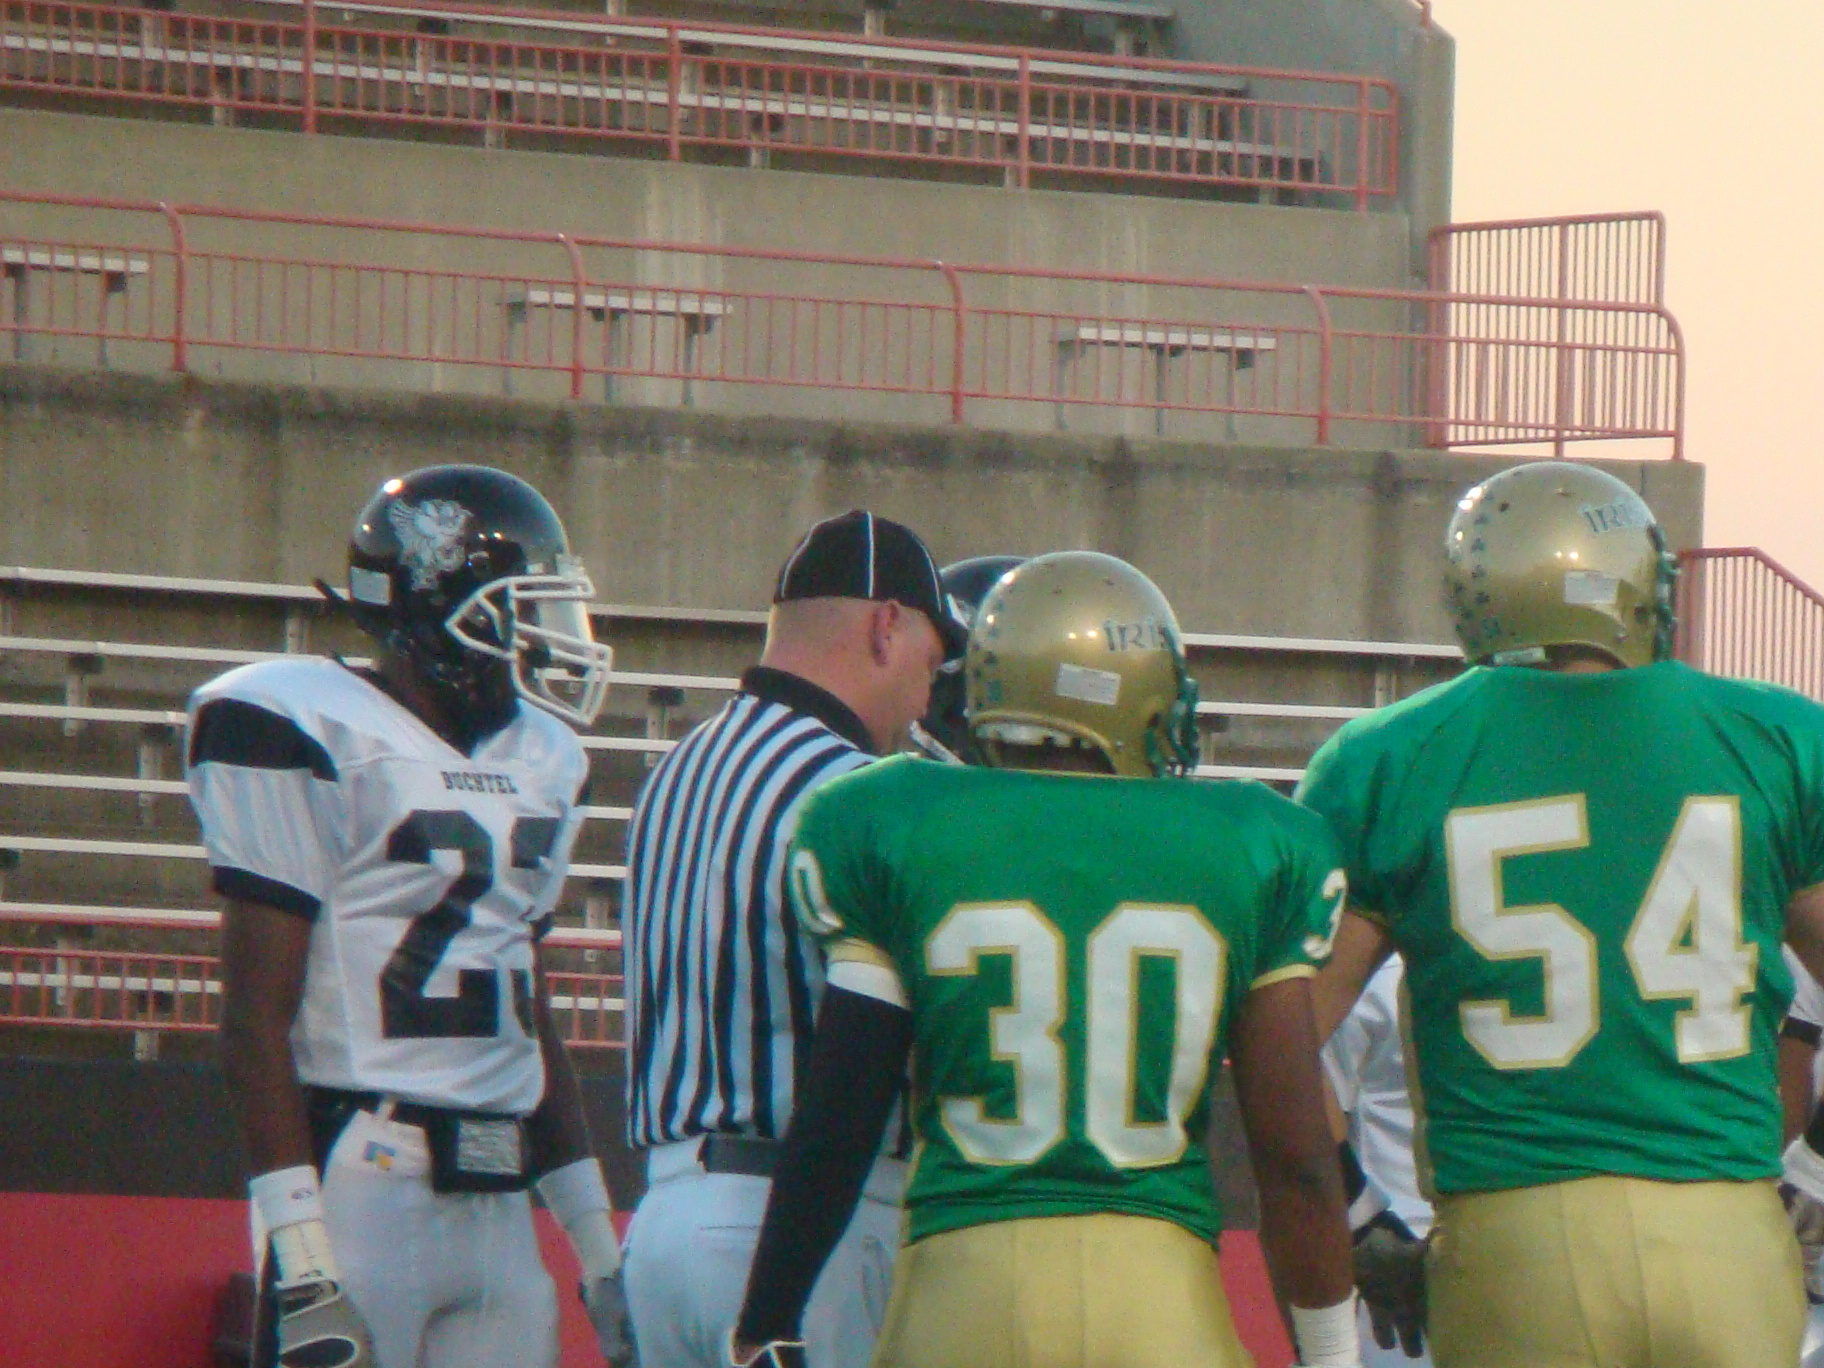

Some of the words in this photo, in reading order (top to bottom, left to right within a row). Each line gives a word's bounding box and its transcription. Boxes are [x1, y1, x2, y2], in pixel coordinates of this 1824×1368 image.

[441, 772, 517, 793] BUCHTEL
[925, 900, 1231, 1168] 30
[1445, 793, 1758, 1071] 54
